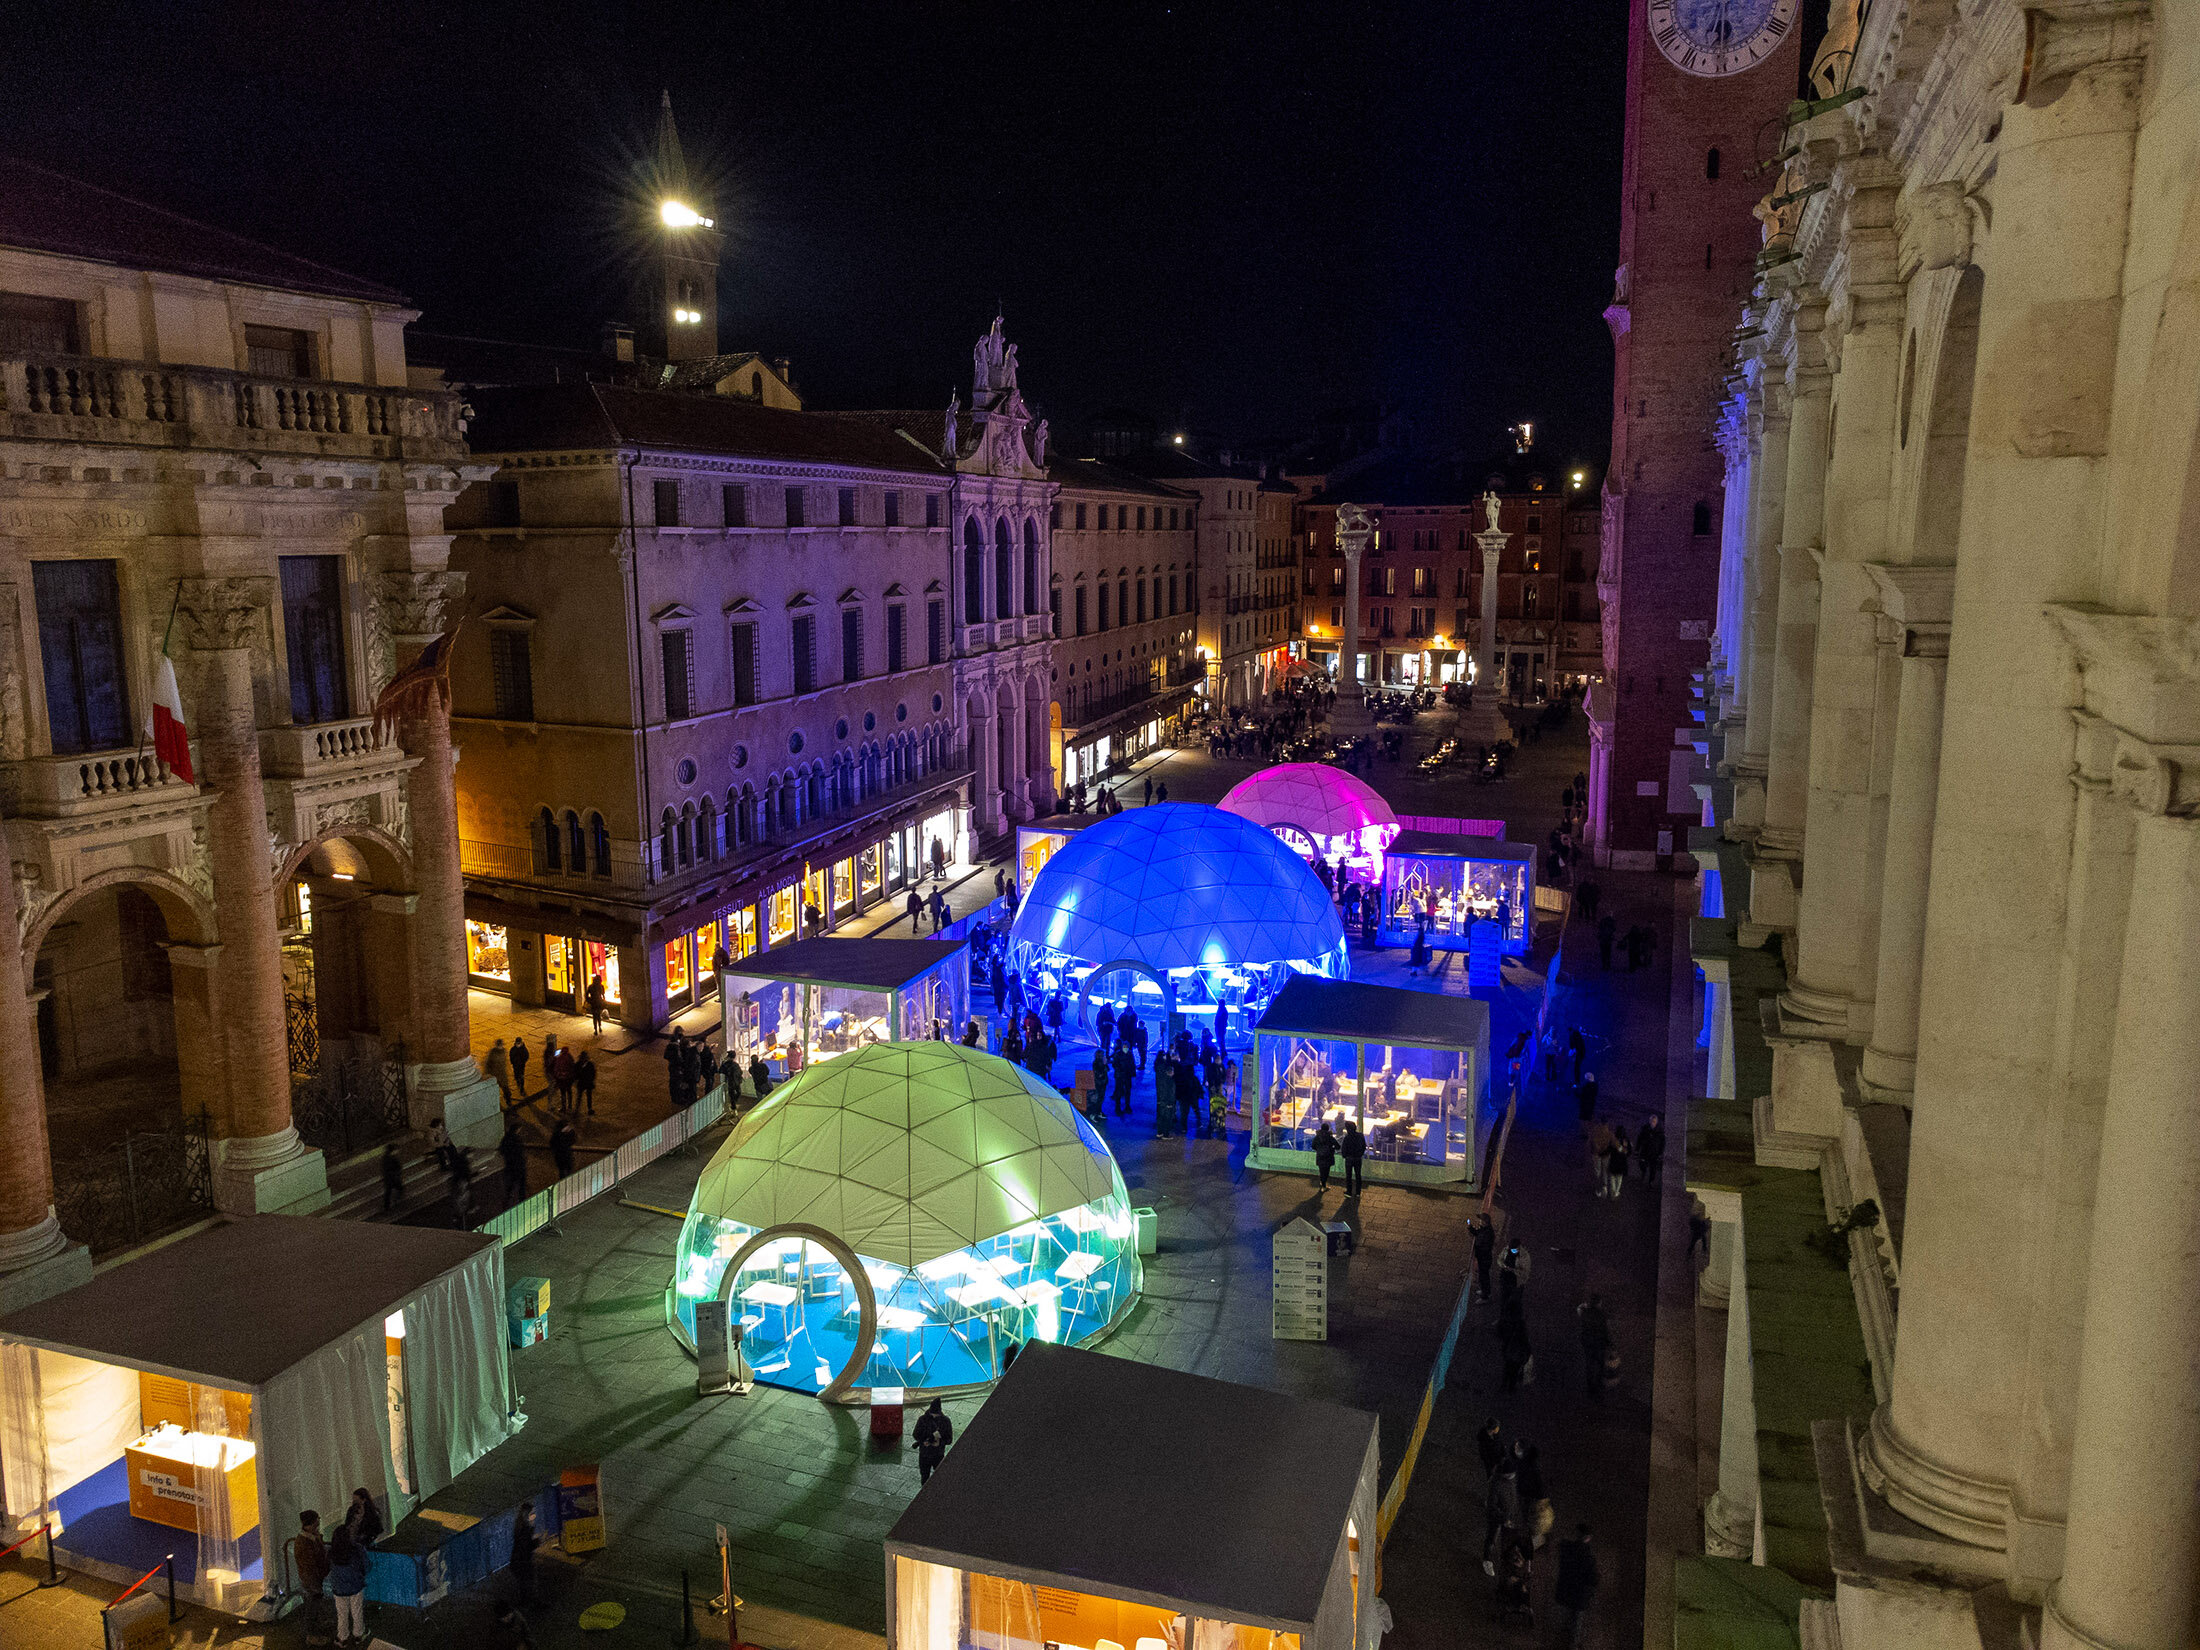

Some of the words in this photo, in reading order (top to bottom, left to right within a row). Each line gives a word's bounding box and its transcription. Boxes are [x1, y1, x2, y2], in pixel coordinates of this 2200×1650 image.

[712, 898, 745, 921] TESSUTI
[757, 884, 776, 902] ALTA
[776, 873, 797, 892] MODA
[147, 1473, 164, 1484] Info
[165, 1477, 172, 1486] &
